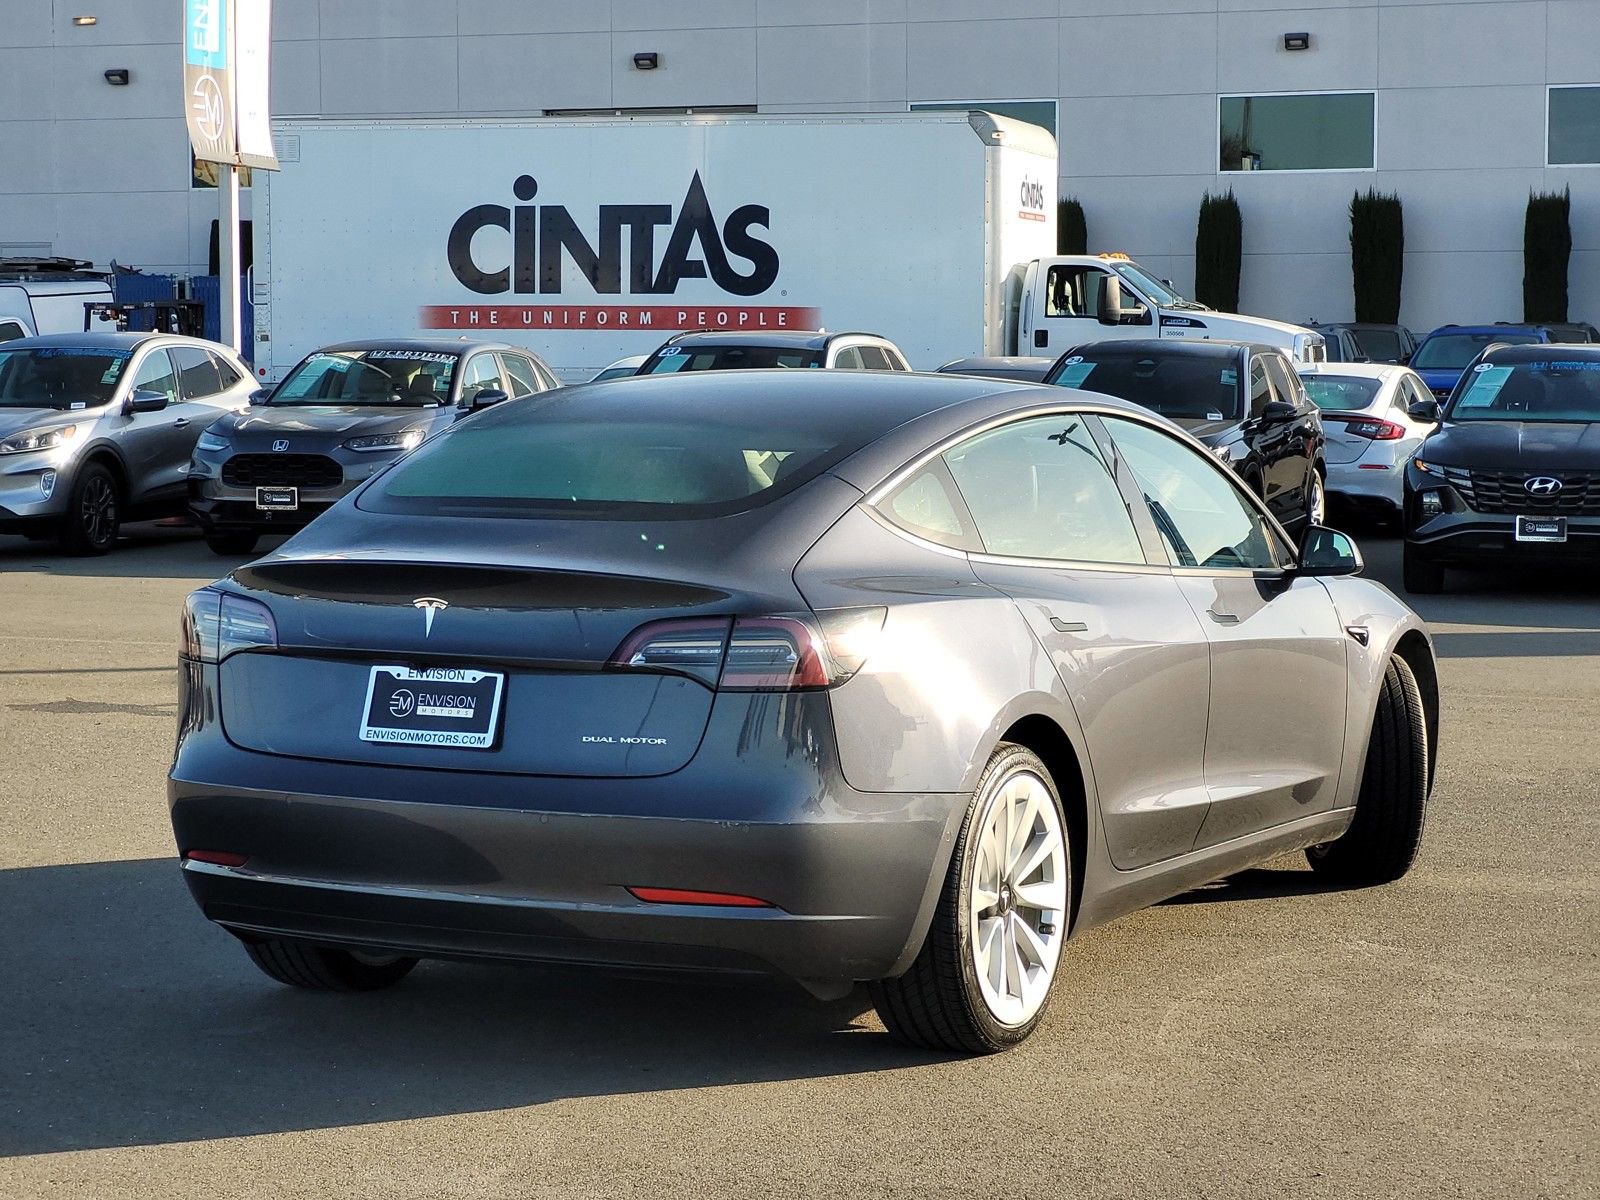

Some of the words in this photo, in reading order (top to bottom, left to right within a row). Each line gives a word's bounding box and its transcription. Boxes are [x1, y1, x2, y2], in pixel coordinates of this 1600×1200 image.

[450, 311, 499, 324] THE
[522, 311, 652, 325] UNIFORM
[678, 311, 788, 326] PEOPLE
[386, 350, 458, 361] CERTIFIED
[408, 668, 466, 680] ENVISION
[417, 694, 477, 708] ENVISION
[421, 708, 470, 716] MOTORS
[366, 729, 486, 745] ENVISIONMOTORS.COM
[620, 737, 667, 745] MOTOR
